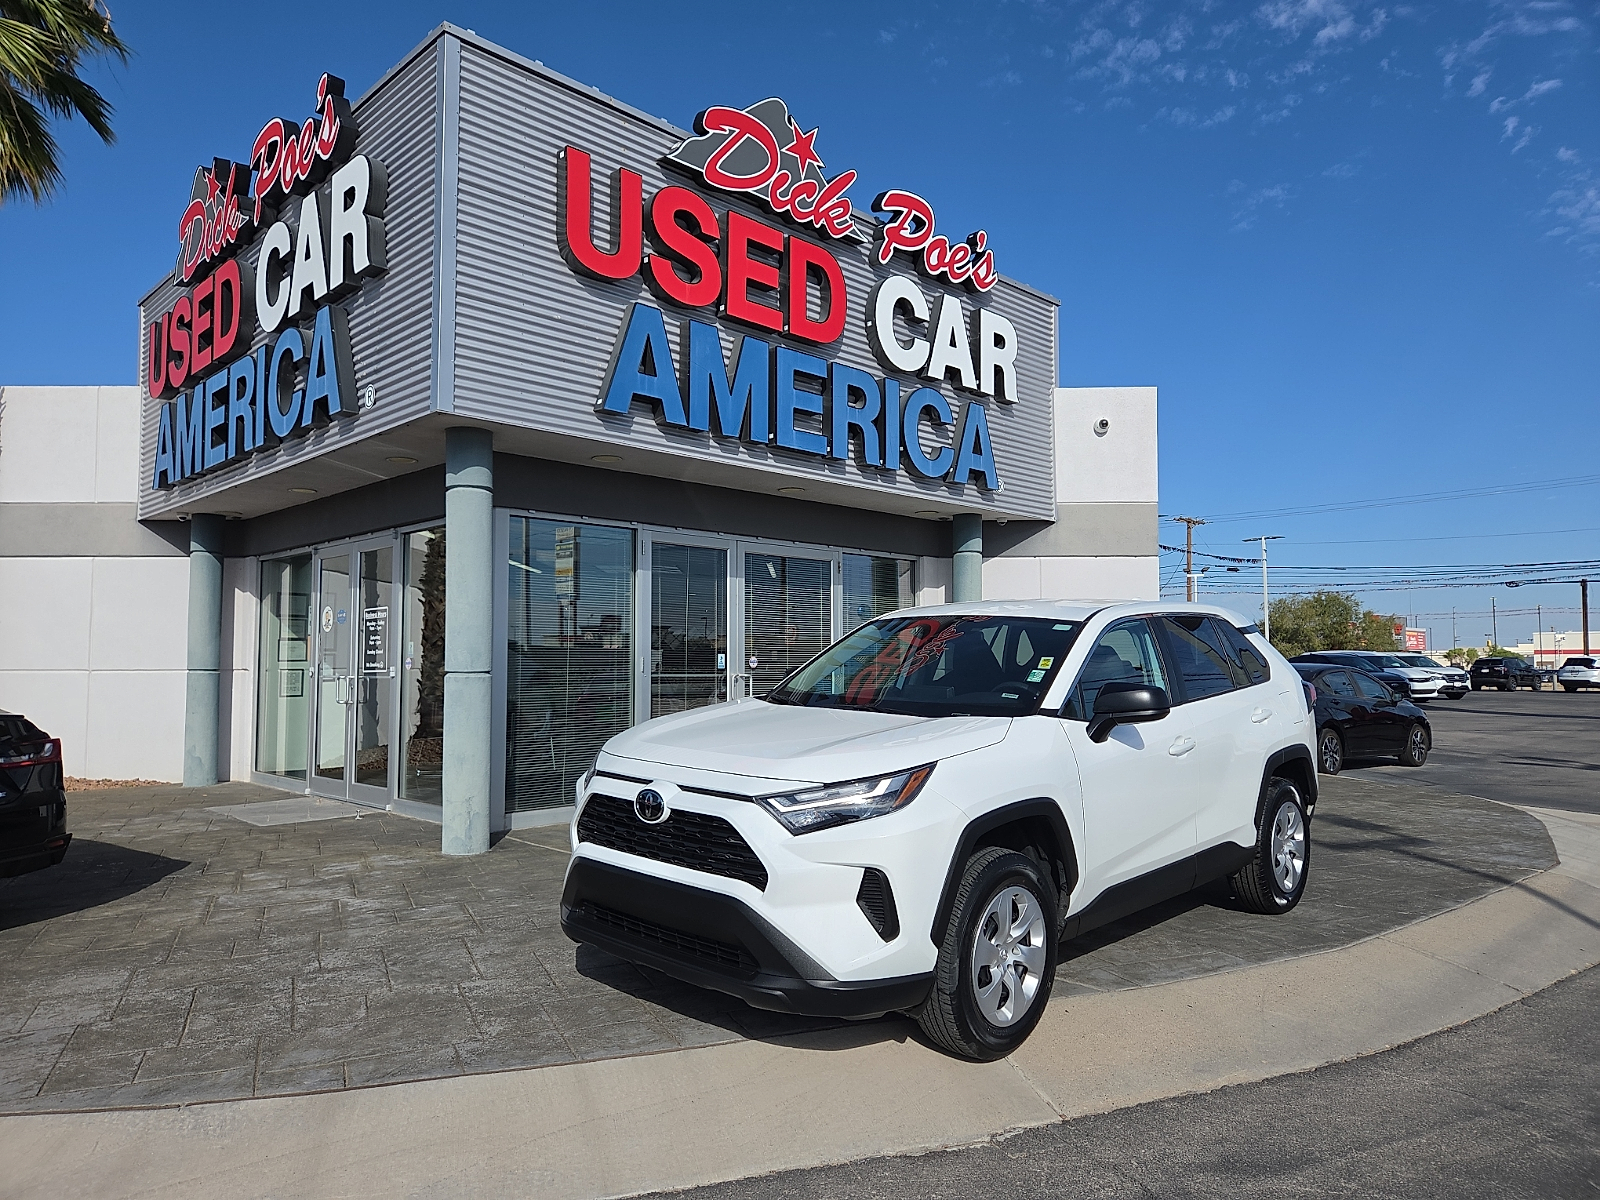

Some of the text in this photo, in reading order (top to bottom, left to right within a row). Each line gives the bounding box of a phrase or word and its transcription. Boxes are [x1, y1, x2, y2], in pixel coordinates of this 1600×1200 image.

[149, 155, 371, 399] USED CAR
[180, 72, 341, 283] Dick Poe's
[565, 144, 1019, 405] USED CAR
[702, 105, 999, 293] Dick Poe's
[152, 304, 342, 490] AMERICA
[603, 302, 1000, 491] AMERICA
